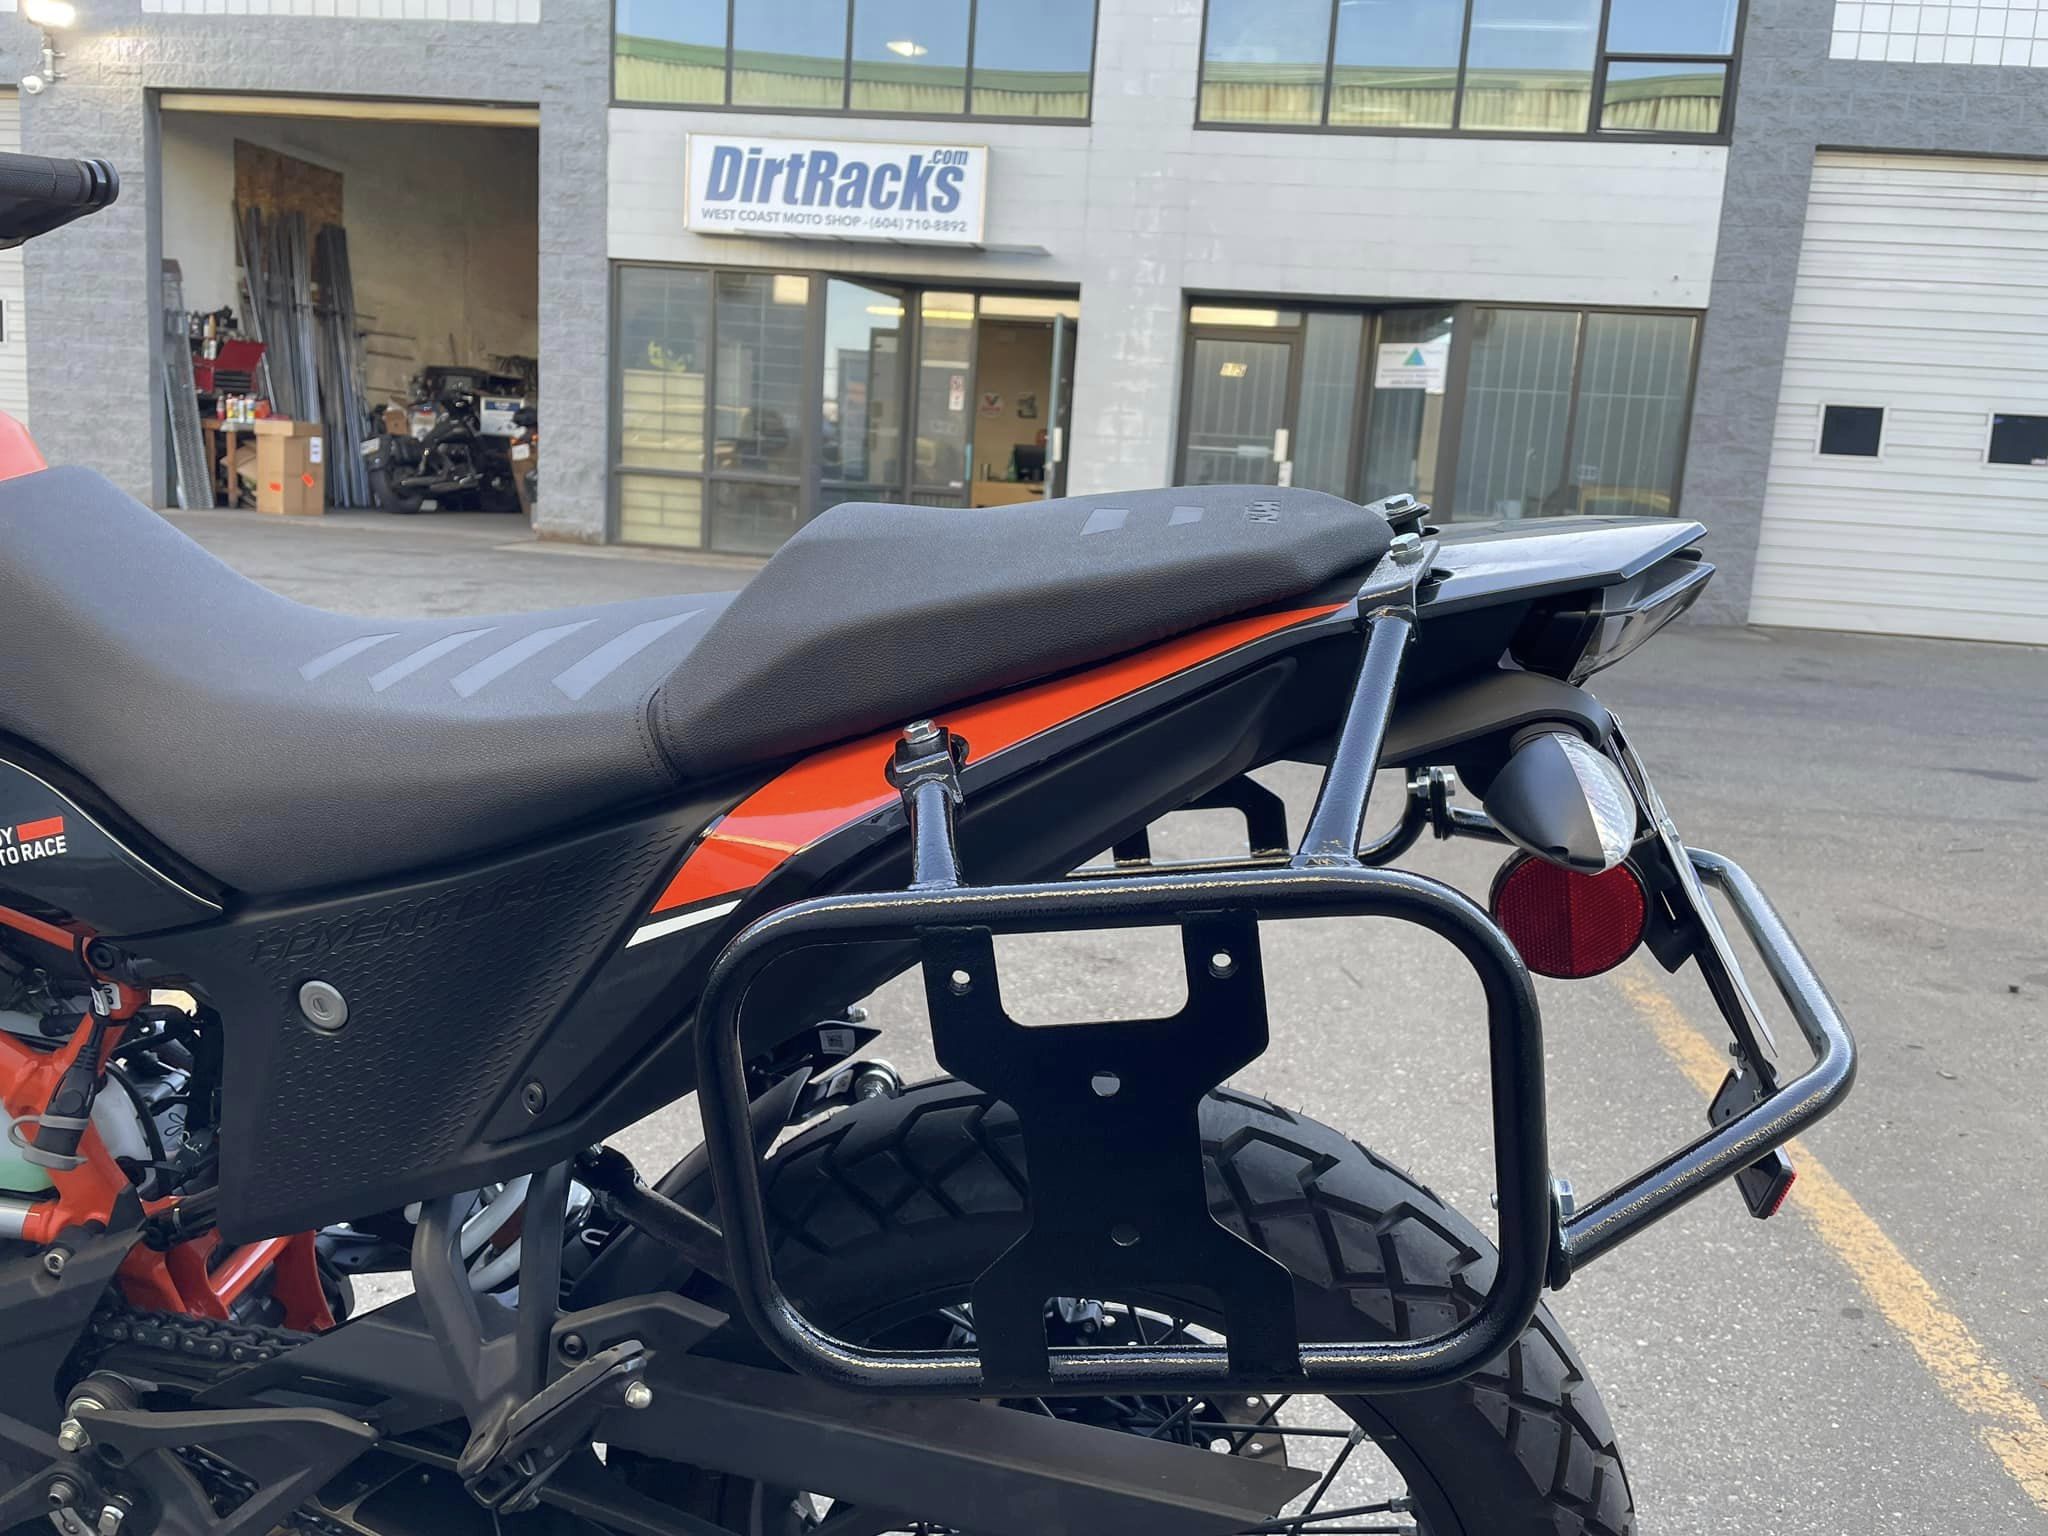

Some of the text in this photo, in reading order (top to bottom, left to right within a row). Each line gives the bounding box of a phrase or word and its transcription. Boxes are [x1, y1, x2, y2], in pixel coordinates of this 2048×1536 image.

[705, 145, 969, 213] DirtRacks .com
[702, 208, 737, 220] WEST
[738, 209, 780, 223] COAST
[783, 212, 823, 225] MOTO
[824, 213, 861, 227] SHOP
[0, 835, 68, 867] TO RACE
